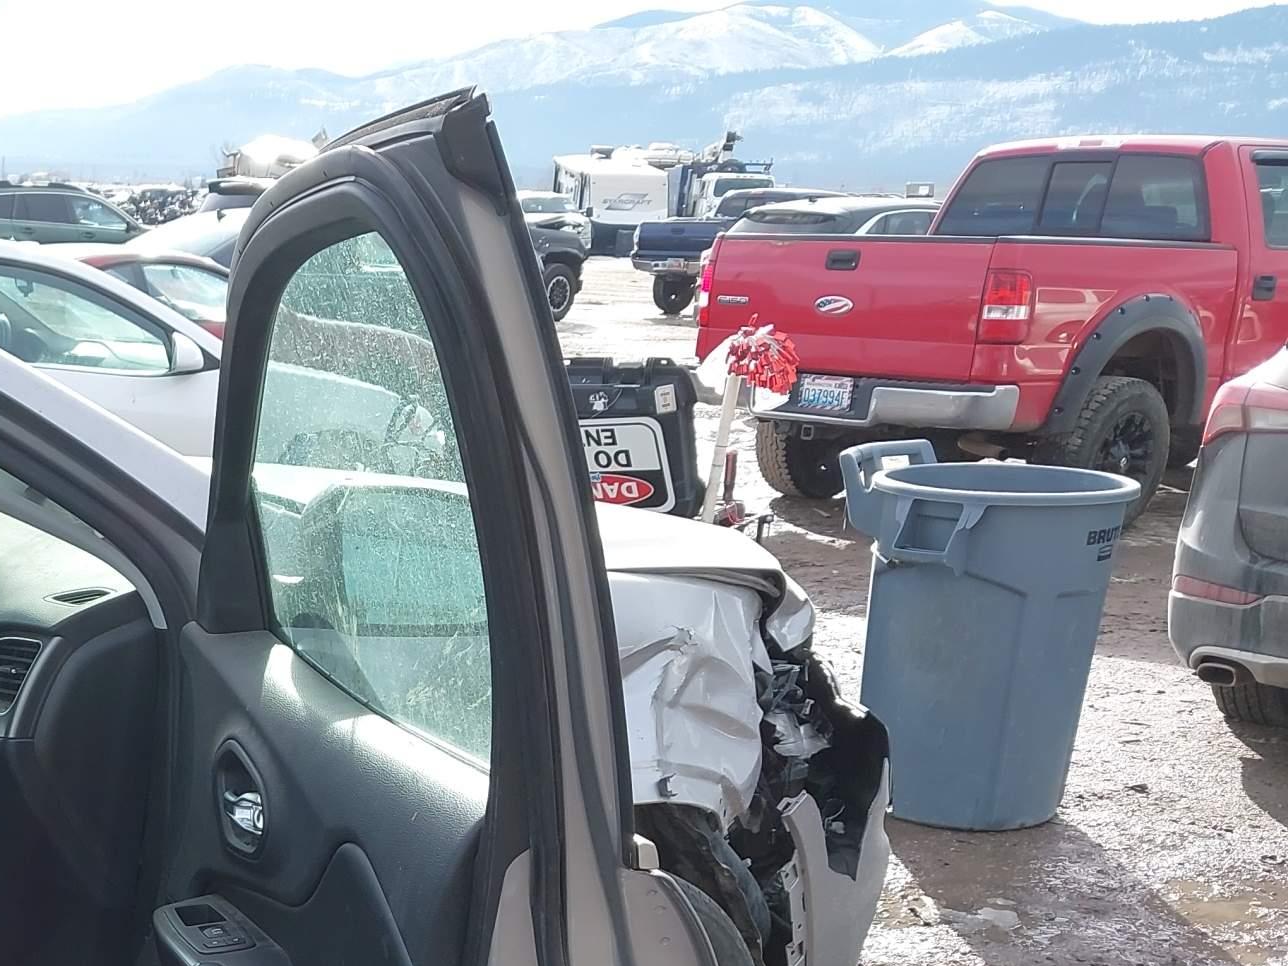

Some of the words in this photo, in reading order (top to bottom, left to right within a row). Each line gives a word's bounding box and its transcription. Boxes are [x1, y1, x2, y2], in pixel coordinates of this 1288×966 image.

[583, 428, 618, 447] EN
[594, 449, 633, 468] DO
[1086, 525, 1121, 546] BRUT
